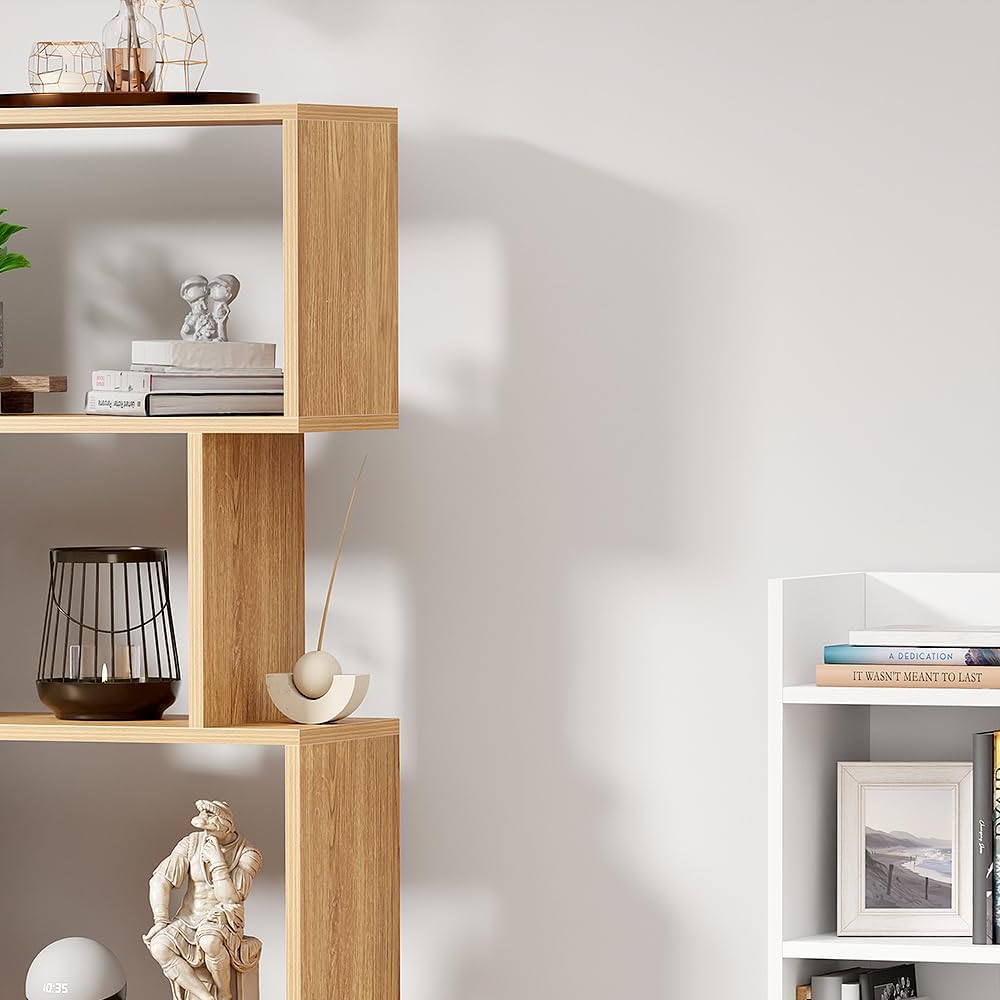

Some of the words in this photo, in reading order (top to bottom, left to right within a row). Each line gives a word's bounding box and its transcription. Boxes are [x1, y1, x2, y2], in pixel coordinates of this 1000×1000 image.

[889, 652, 894, 660] A
[898, 652, 953, 660] DEDICATION
[853, 671, 863, 681] IT
[865, 671, 901, 682] WASN'T
[903, 671, 939, 682] MEANT
[941, 672, 955, 682] TO
[958, 673, 983, 683] LAST
[42, 983, 68, 993] 10:35
